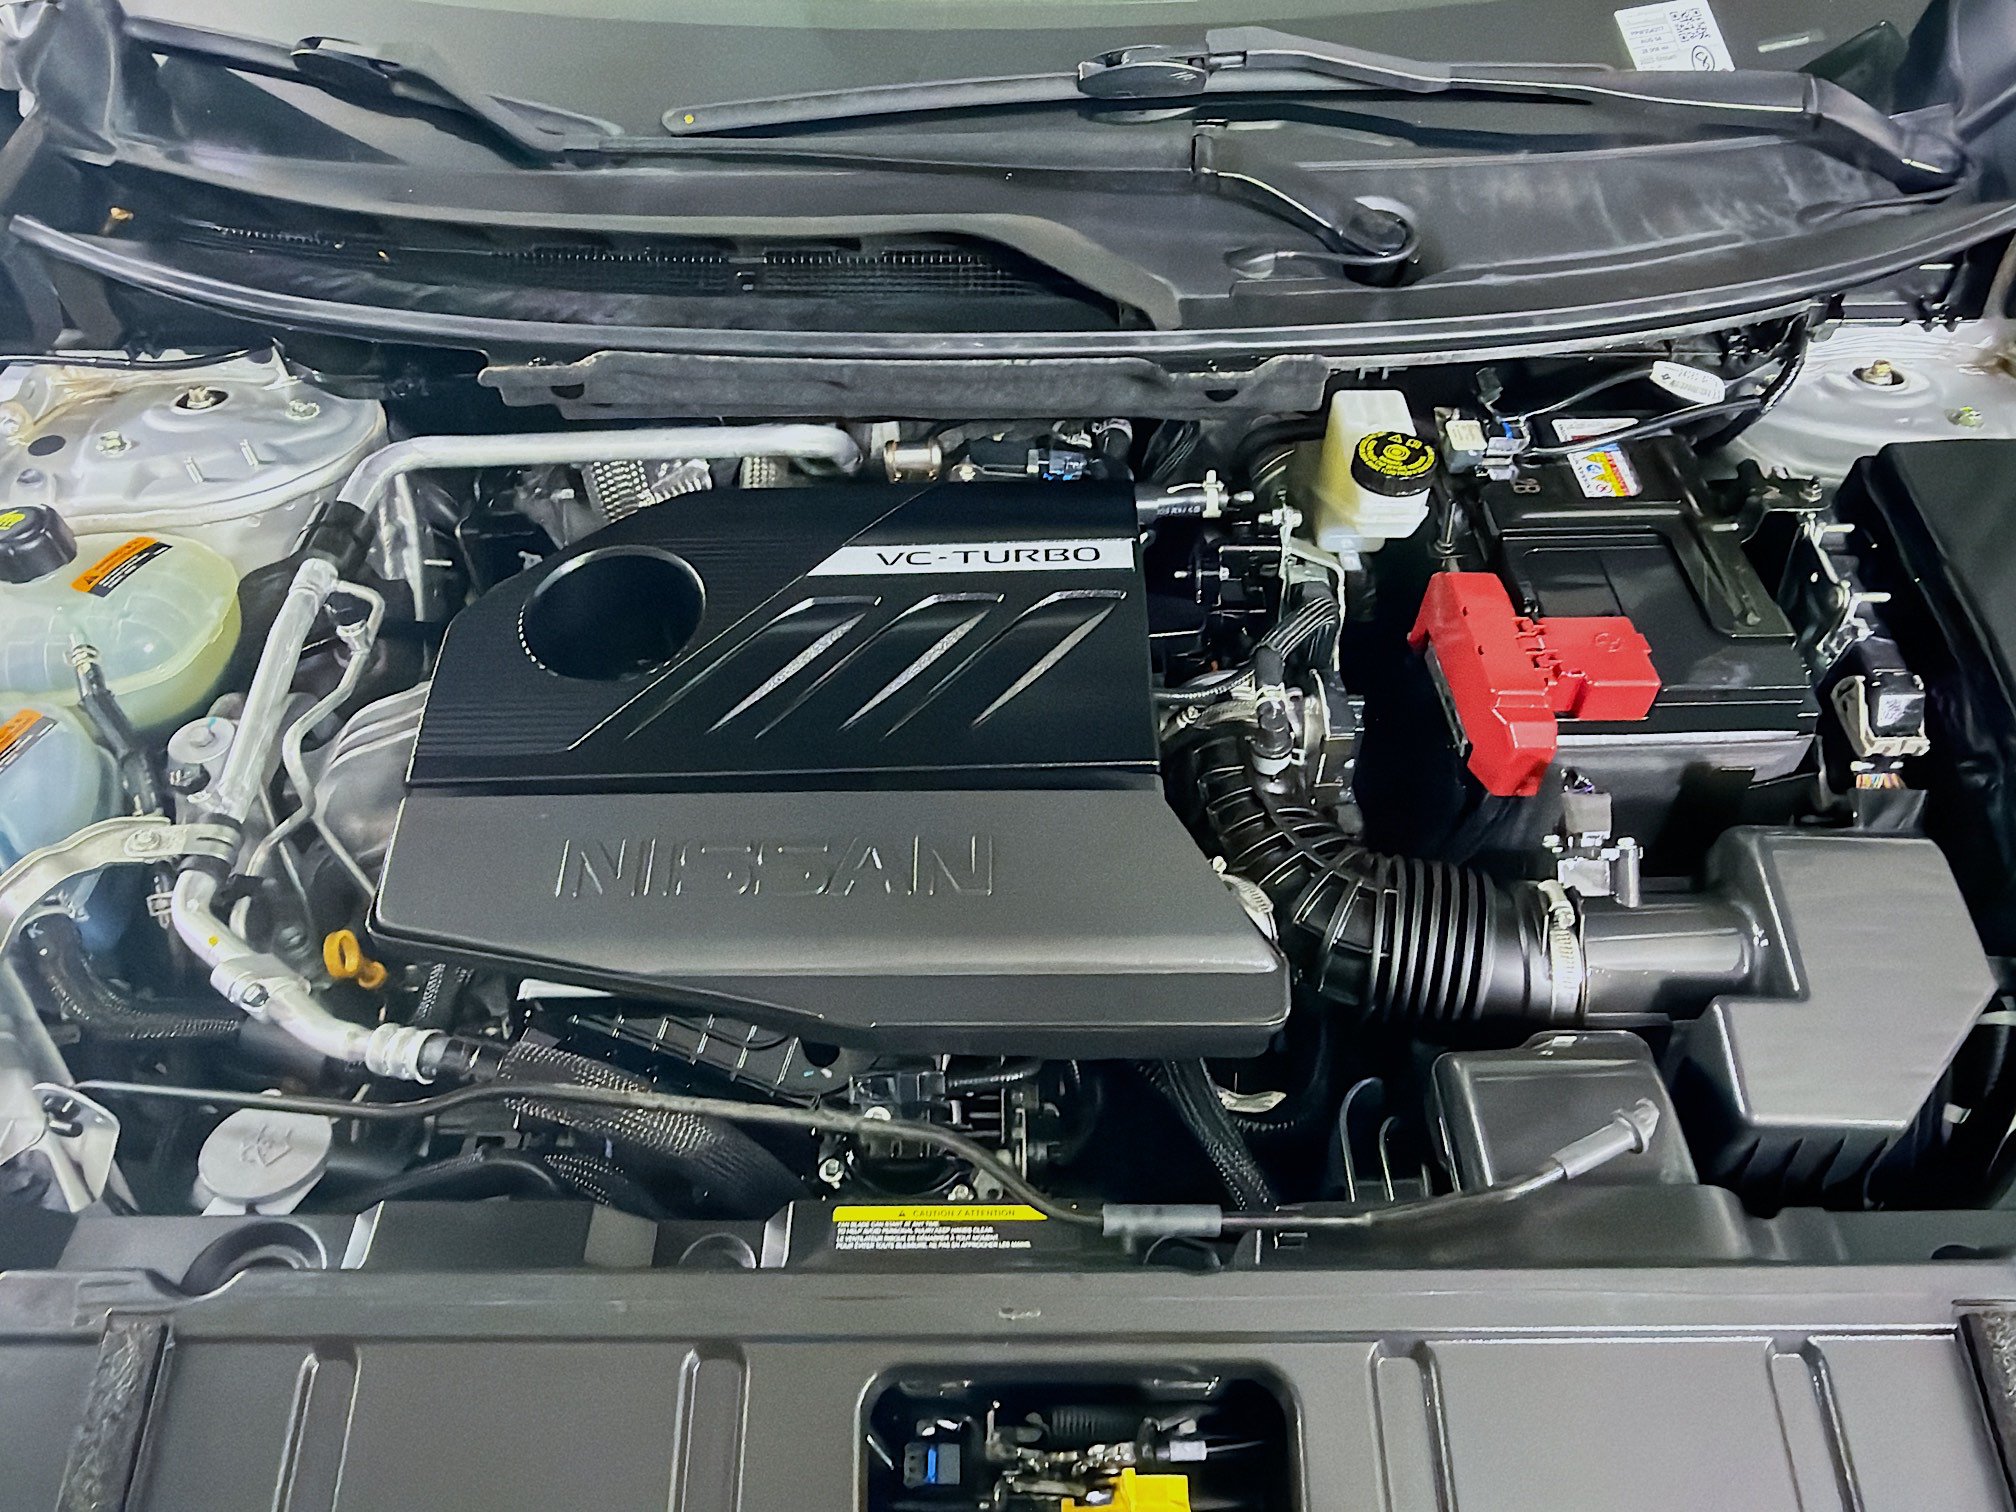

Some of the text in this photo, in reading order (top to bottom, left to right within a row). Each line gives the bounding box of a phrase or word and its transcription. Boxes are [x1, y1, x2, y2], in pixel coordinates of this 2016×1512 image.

[876, 546, 1101, 566] VC-TURBO
[555, 834, 993, 897] NISSAN
[964, 1209, 1015, 1217] ATTENTION
